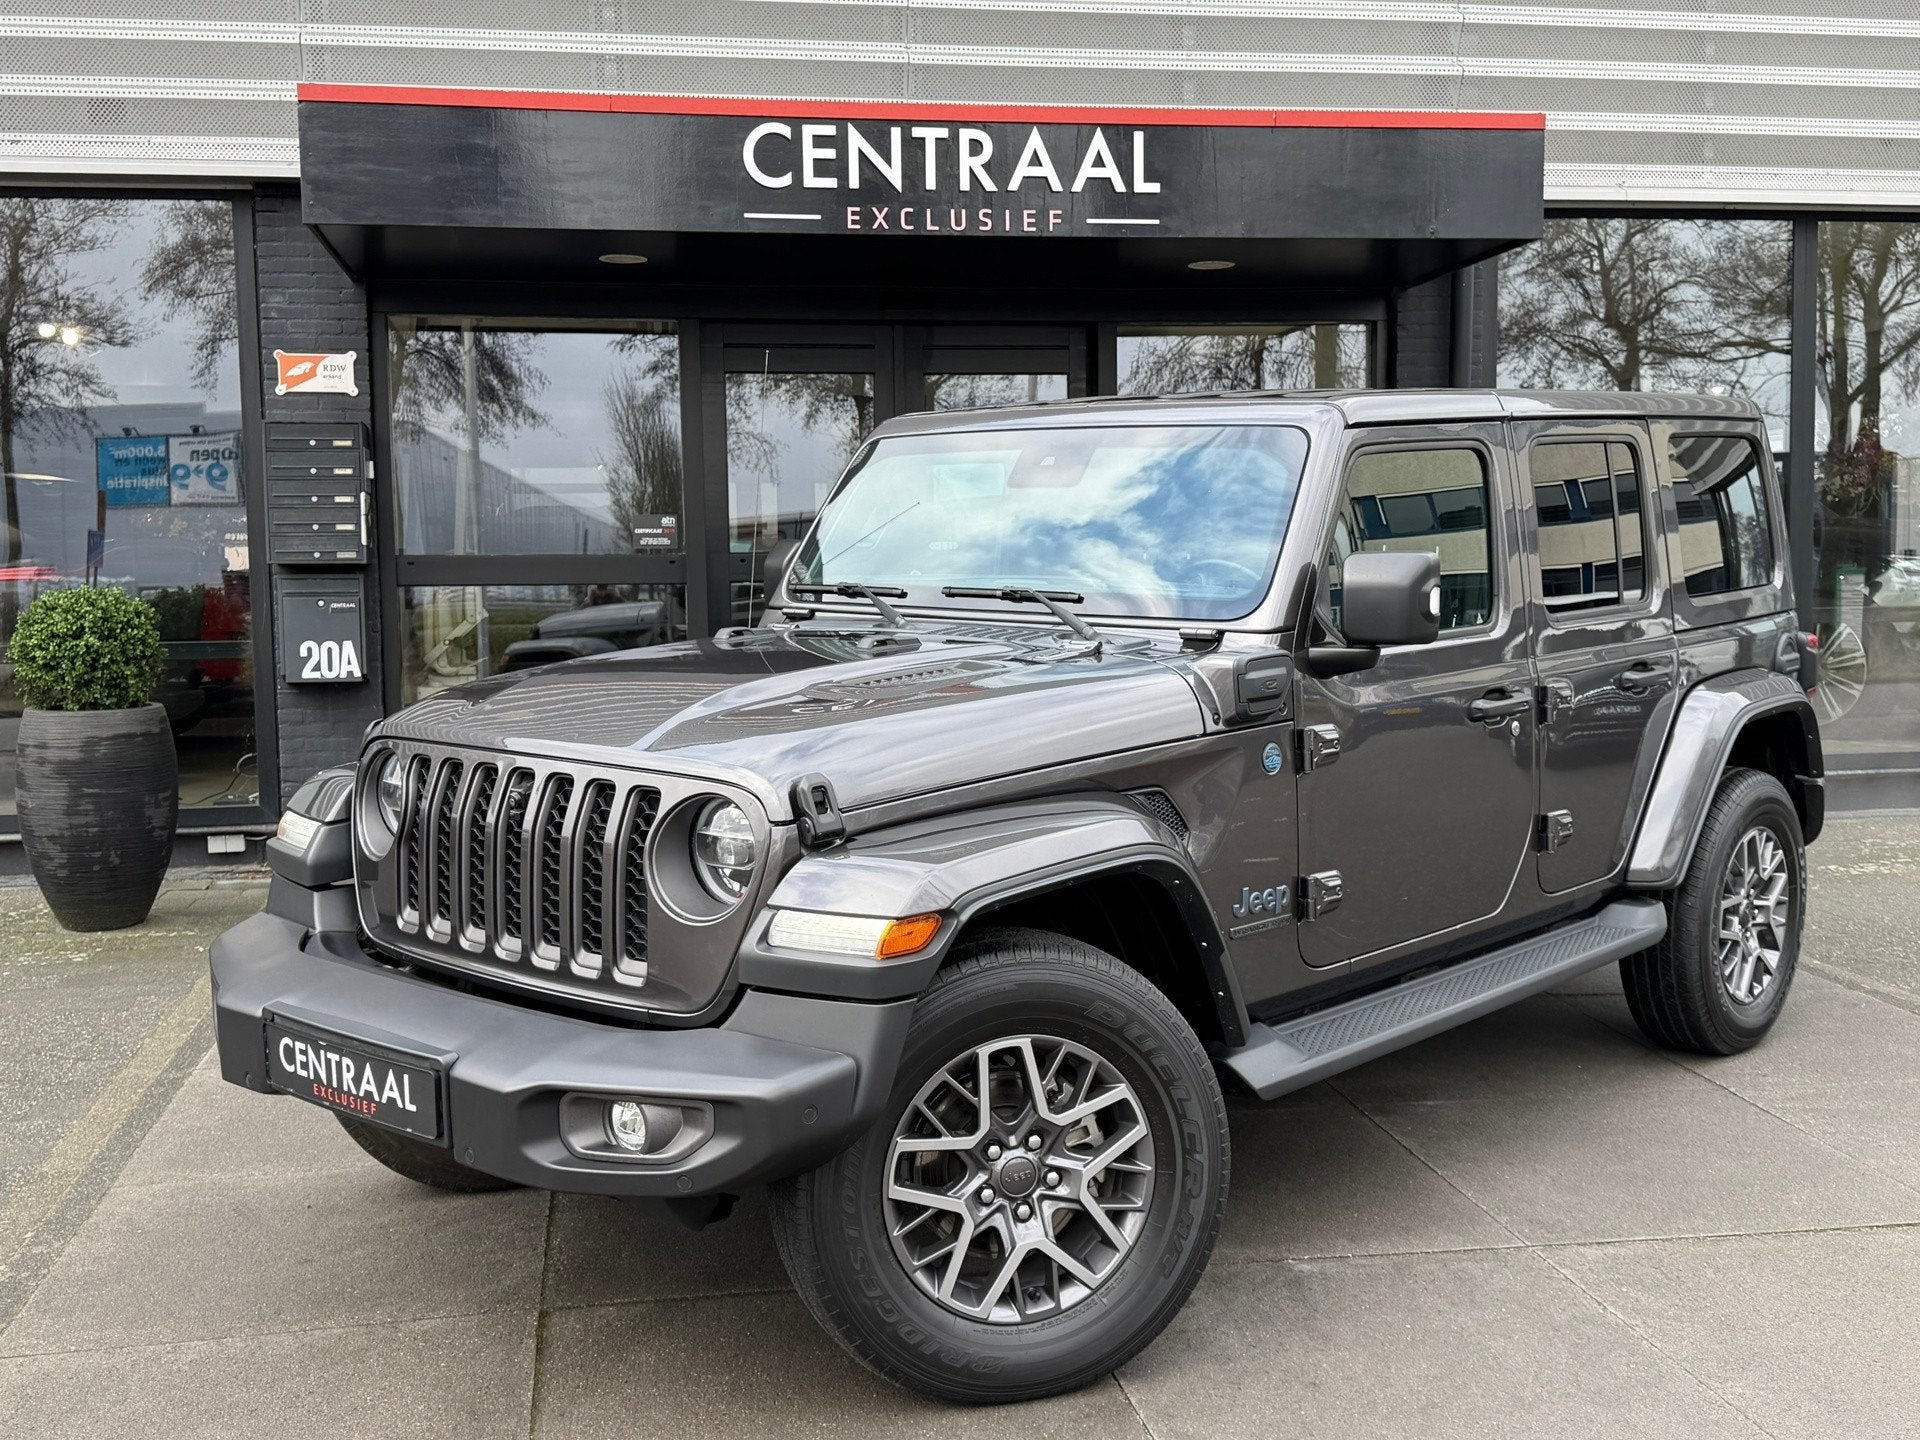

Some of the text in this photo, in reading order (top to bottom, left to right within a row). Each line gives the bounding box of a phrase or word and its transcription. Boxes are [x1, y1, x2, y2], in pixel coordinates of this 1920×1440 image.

[742, 121, 1161, 194] CENTRAAL
[846, 206, 1064, 232] EXCLUSIEF
[322, 364, 346, 372] RDW
[299, 640, 362, 679] 20A
[1232, 884, 1291, 918] Jeep
[278, 1036, 418, 1113] CENTRAAL
[312, 1083, 378, 1115] EXCLUSIEF
